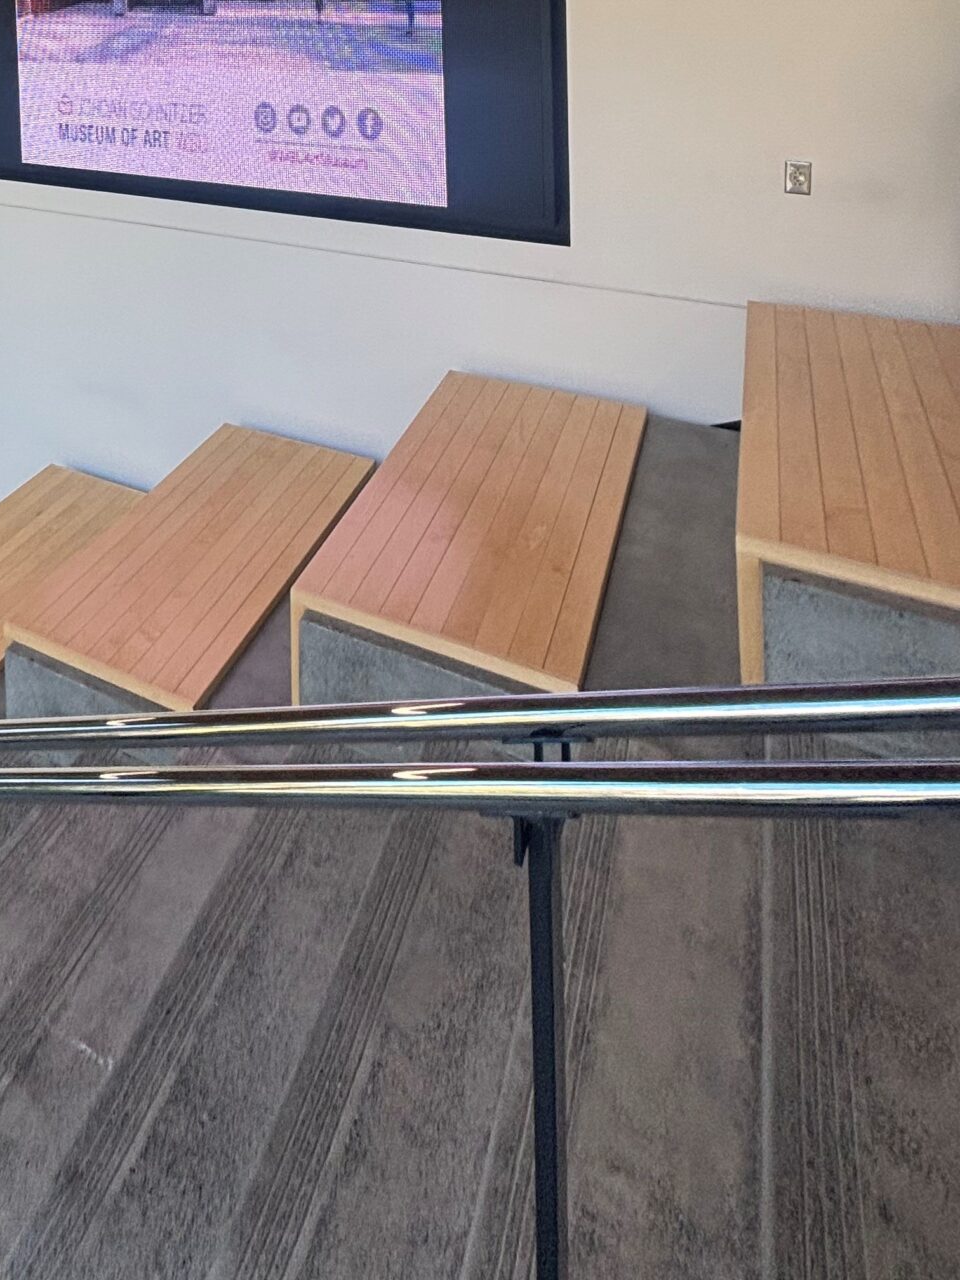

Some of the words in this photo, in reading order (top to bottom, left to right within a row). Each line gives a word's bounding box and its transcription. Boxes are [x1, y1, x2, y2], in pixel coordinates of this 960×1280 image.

[58, 122, 116, 145] MUSEUM
[121, 127, 138, 147] OF
[143, 129, 171, 149] ART
